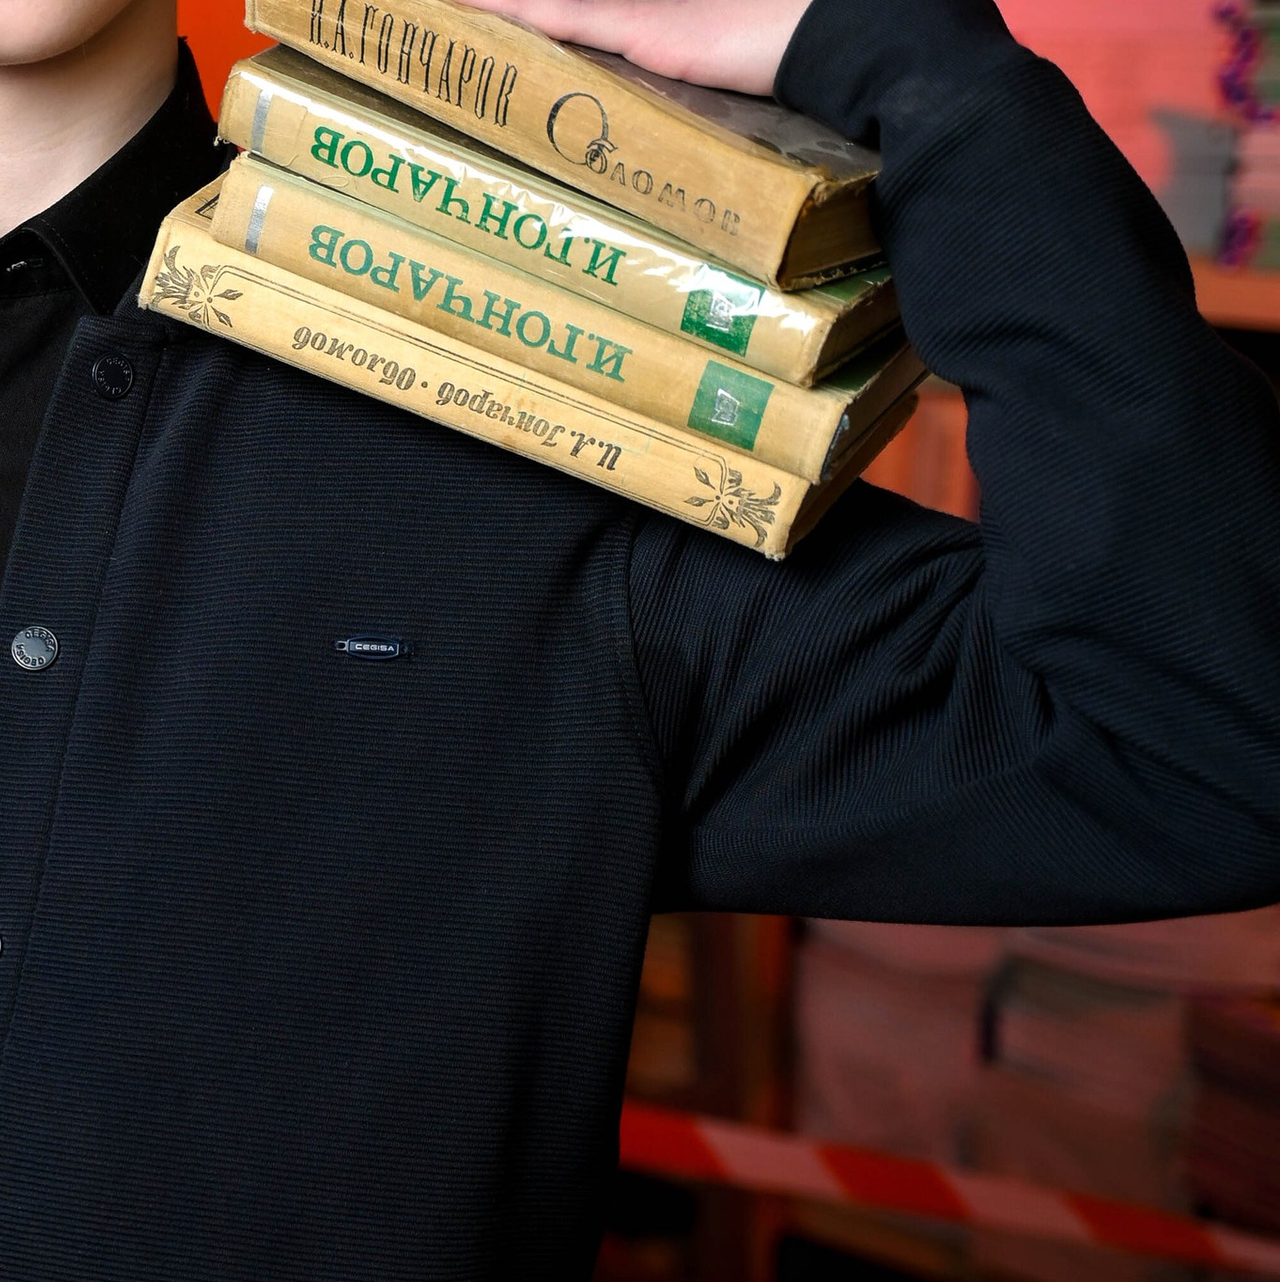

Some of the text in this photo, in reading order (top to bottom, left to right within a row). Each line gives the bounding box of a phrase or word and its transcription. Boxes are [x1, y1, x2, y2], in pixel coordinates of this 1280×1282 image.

[310, 124, 628, 287] И.ГОНЧАРОВ
[307, 223, 634, 384] И.ГОНЧАРОВ
[354, 643, 395, 652] CEGISA
